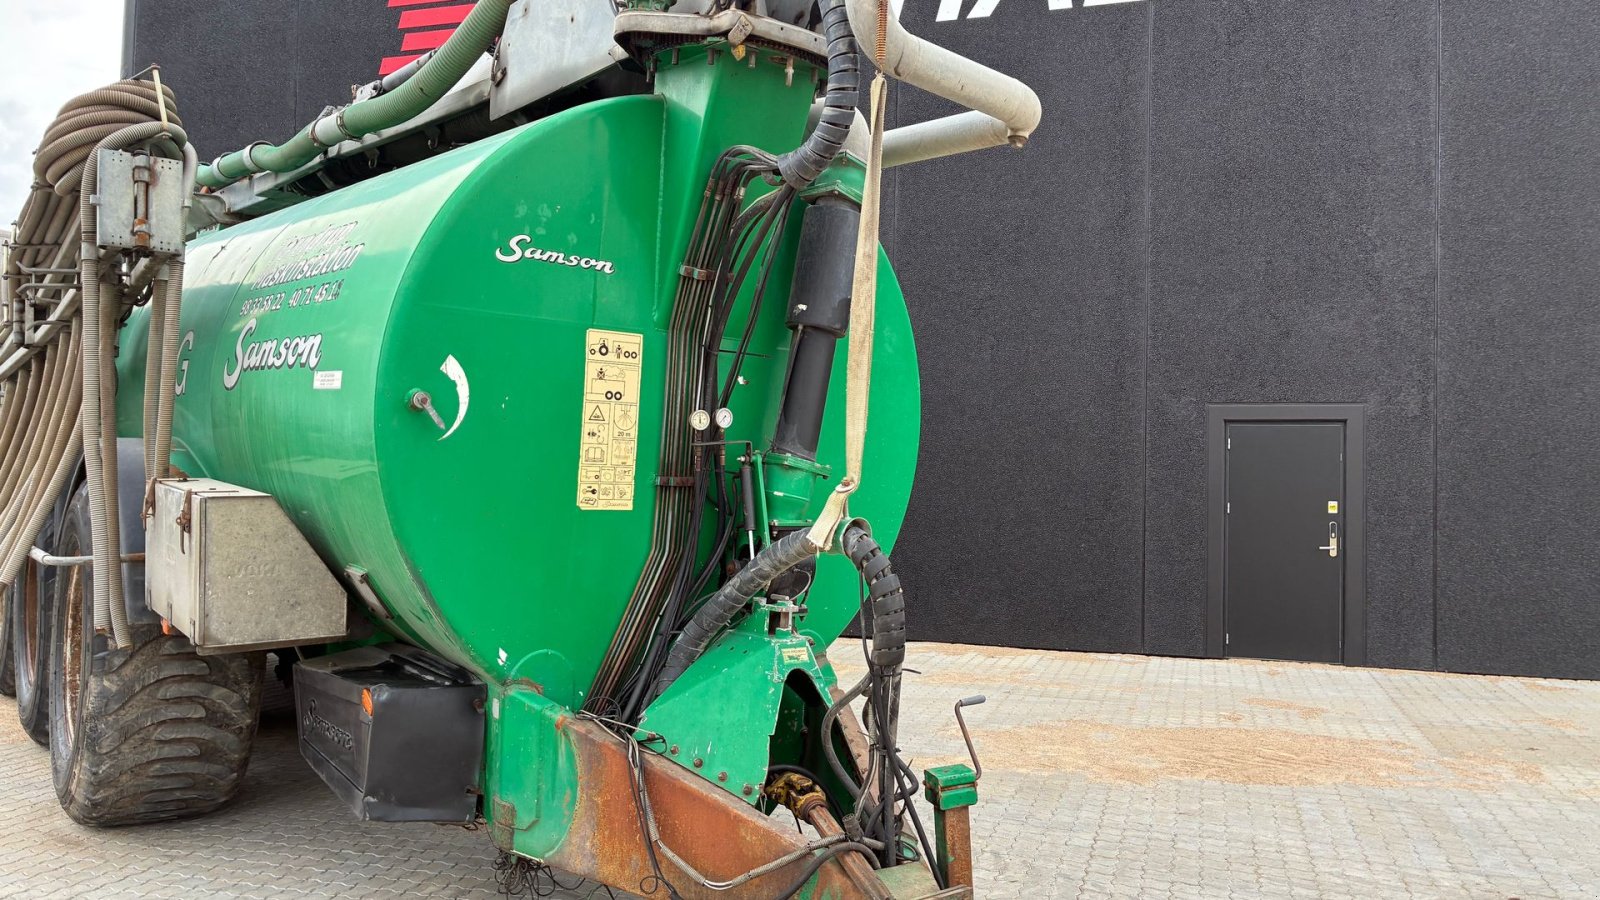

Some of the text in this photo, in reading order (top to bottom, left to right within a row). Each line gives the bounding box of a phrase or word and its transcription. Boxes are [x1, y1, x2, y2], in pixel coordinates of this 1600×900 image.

[495, 234, 614, 274] Samson
[299, 284, 316, 306] 71
[223, 317, 322, 391] Samson
[302, 697, 353, 750] Samson
